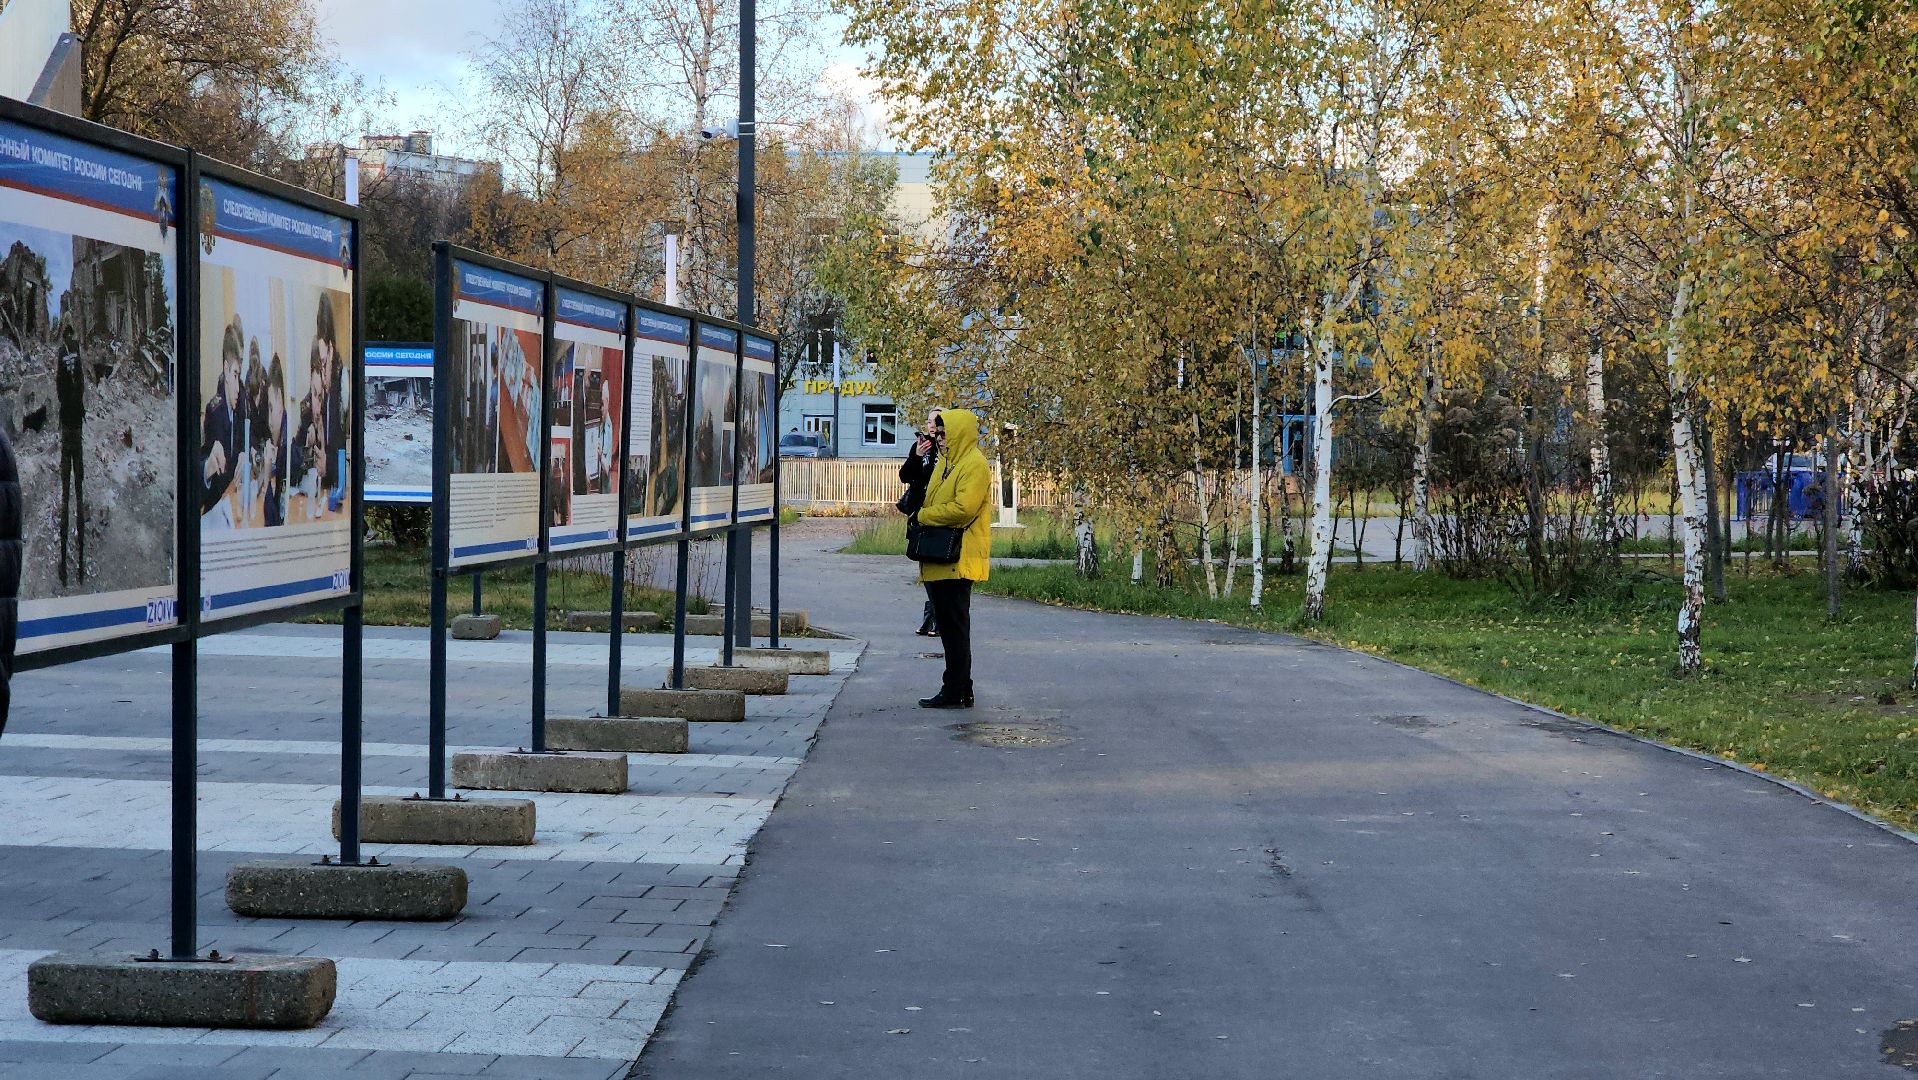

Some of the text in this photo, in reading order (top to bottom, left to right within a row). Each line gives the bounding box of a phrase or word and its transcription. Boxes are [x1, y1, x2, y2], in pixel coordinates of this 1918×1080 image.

[31, 145, 73, 173] КОМИТЕТ
[74, 157, 107, 181] РОССИИ
[108, 167, 142, 192] СЕГОДНЯ
[804, 380, 880, 397] ПРОДУК
